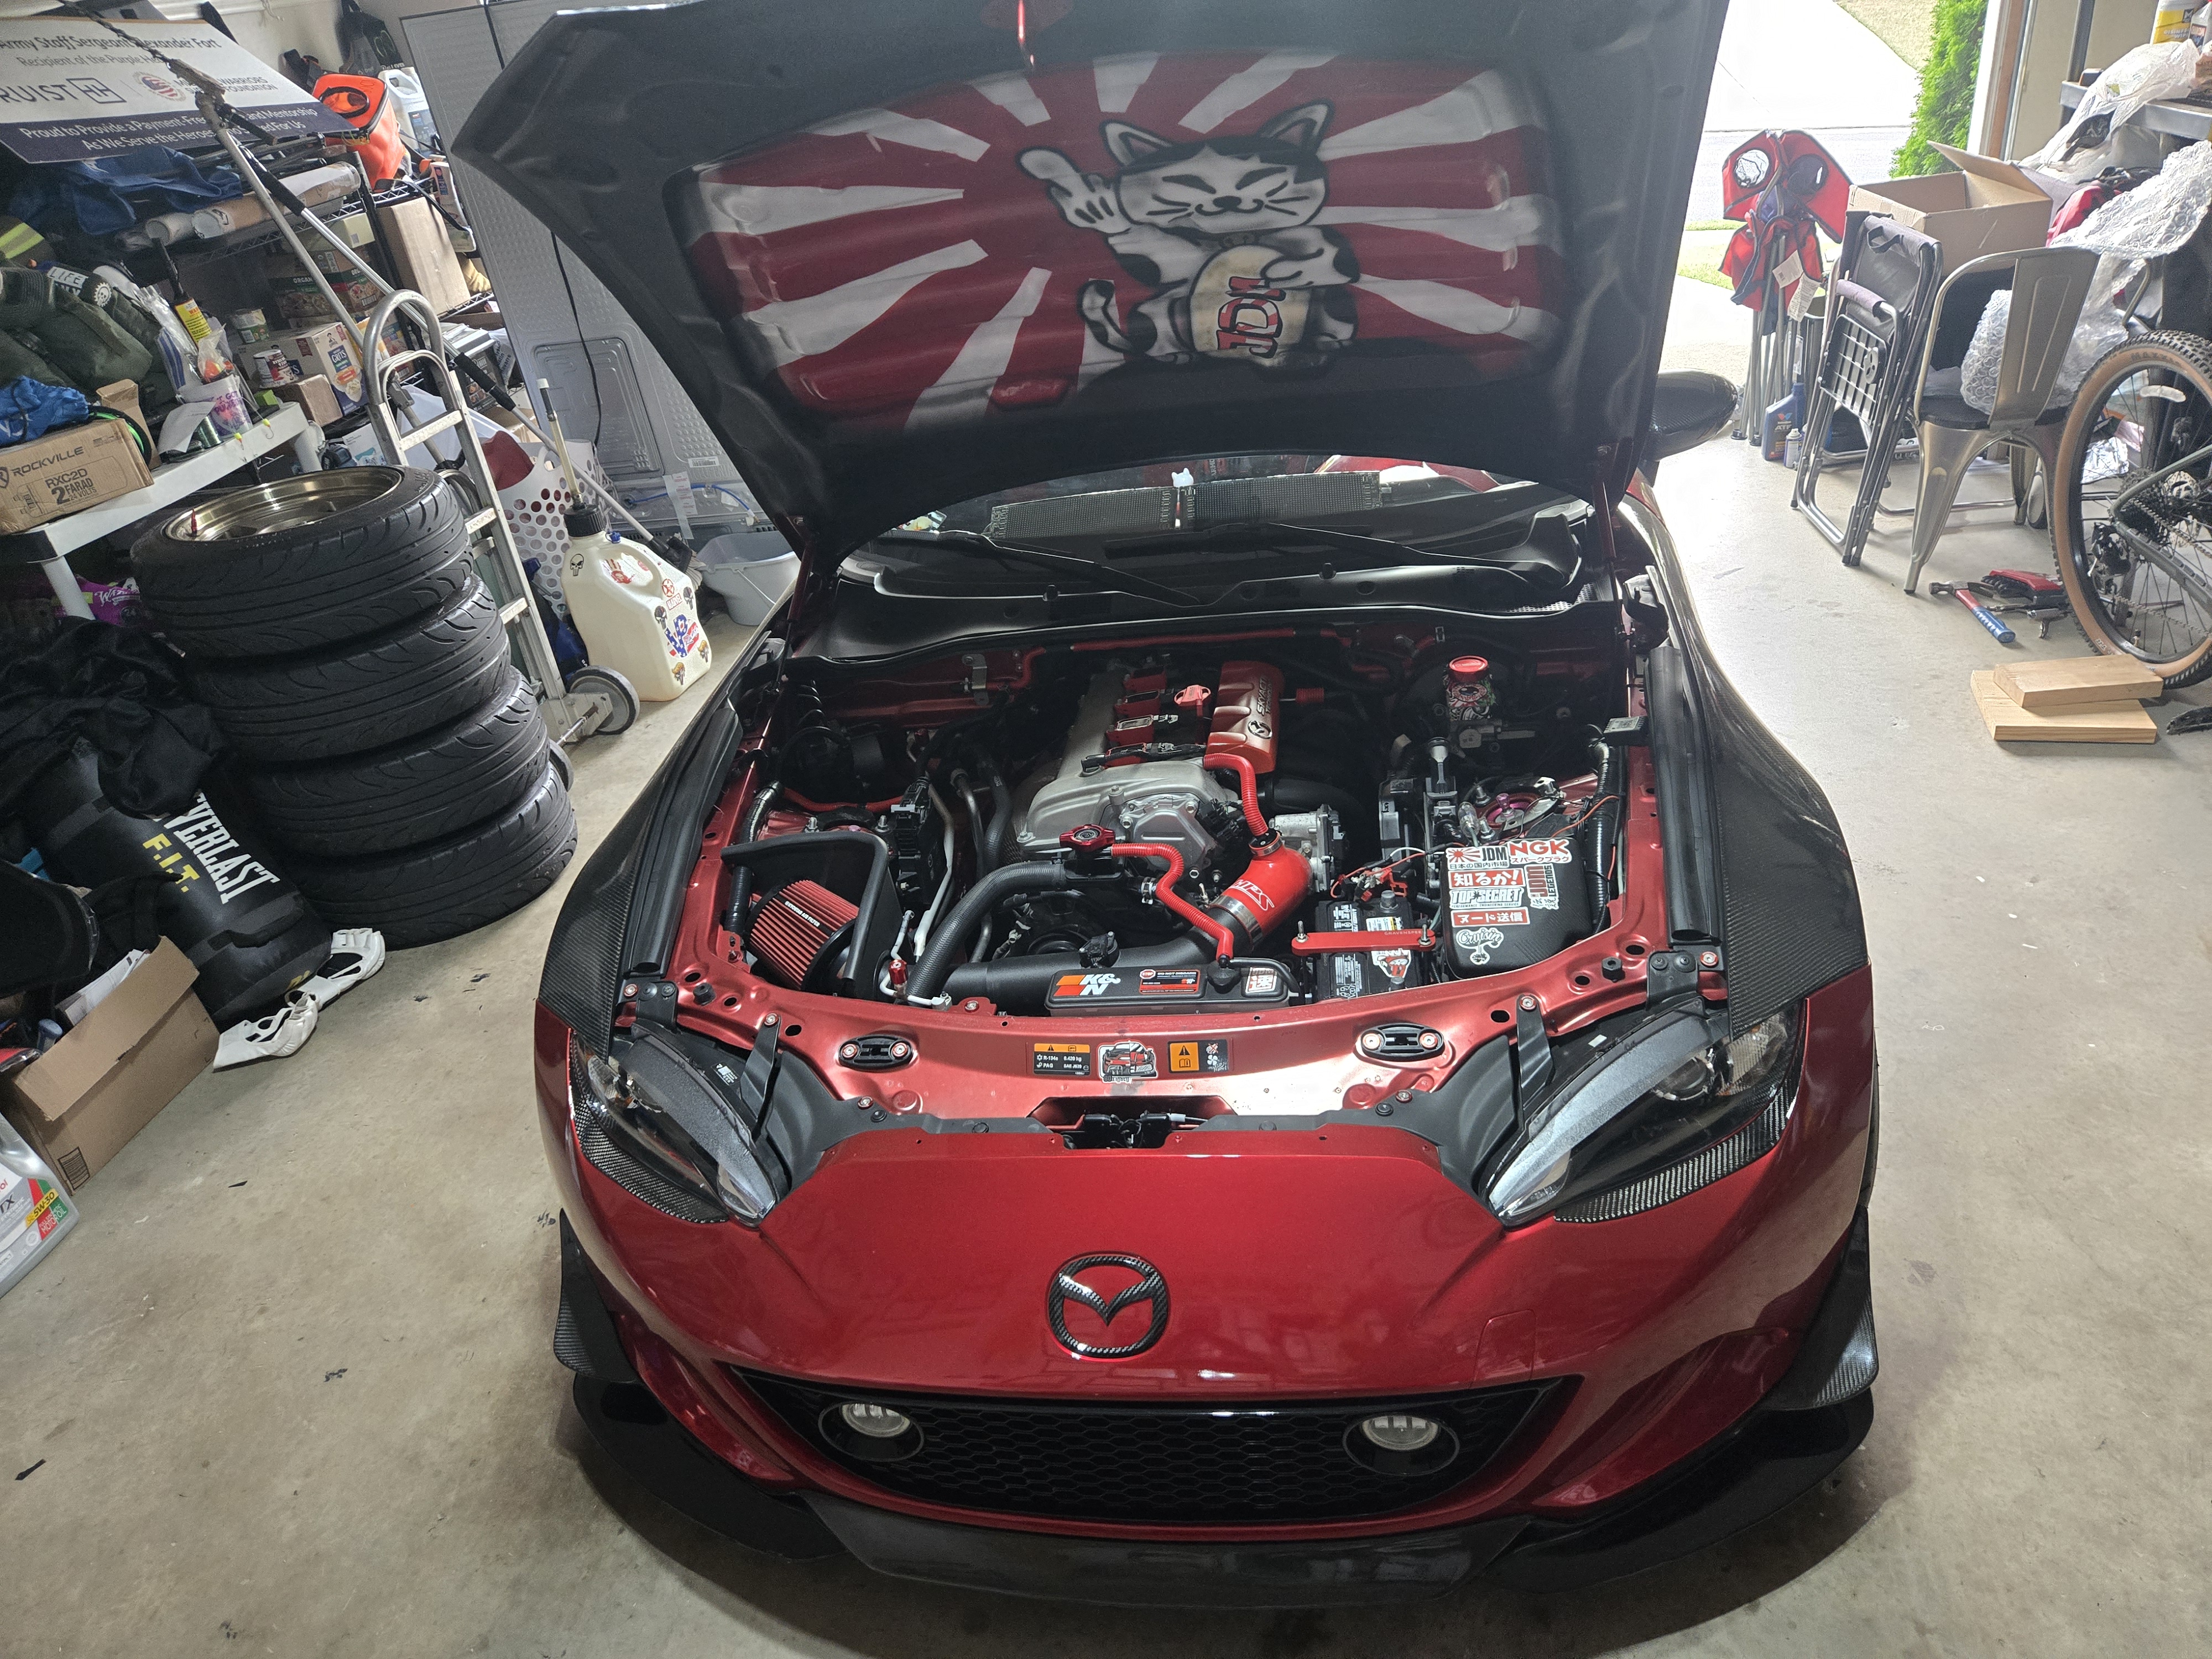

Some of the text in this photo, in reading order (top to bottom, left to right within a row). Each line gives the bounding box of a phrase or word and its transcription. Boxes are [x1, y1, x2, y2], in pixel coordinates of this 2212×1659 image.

[0, 35, 222, 51] Army Staff Sergeant lexander Fort
[17, 56, 74, 68] Recipient
[107, 54, 141, 65] Purple
[217, 76, 268, 86] WARRIORS
[225, 84, 278, 92] FOUNDATION
[20, 127, 64, 138] Proud
[75, 123, 128, 135] Provide
[248, 111, 265, 120] and
[263, 107, 317, 118] Mentorship
[82, 139, 100, 150] As
[97, 137, 123, 149] We
[121, 135, 159, 147] Serve
[170, 129, 216, 142] Heroes
[270, 121, 291, 131] For
[289, 119, 306, 130] Us
[50, 268, 82, 285] LIFE
[331, 349, 347, 363] GRITS
[11, 446, 84, 477] ROCKVILLE
[44, 468, 88, 489] RXC2D
[51, 486, 71, 505] 2
[66, 477, 94, 495] FARAD
[78, 487, 97, 498] VOLTS
[1256, 675, 1267, 716] SKYACTI
[1482, 847, 1508, 862] JDM
[1509, 839, 1569, 855] NGK
[142, 833, 200, 893] F.I.T.
[1449, 861, 1508, 869] 日本の国内市場
[1526, 865, 1548, 897] JDM
[1544, 865, 1557, 897] LEGENDS
[1452, 888, 1521, 904] TOP SECRET
[807, 916, 820, 927] FILTER
[1457, 911, 1523, 924] ヌード送信
[1458, 929, 1503, 945] Cruisin
[0, 1193, 15, 1214] TX
[33, 1191, 55, 1217] 5W-30
[41, 1214, 60, 1234] MOTOR
[56, 1208, 67, 1218] OIL
